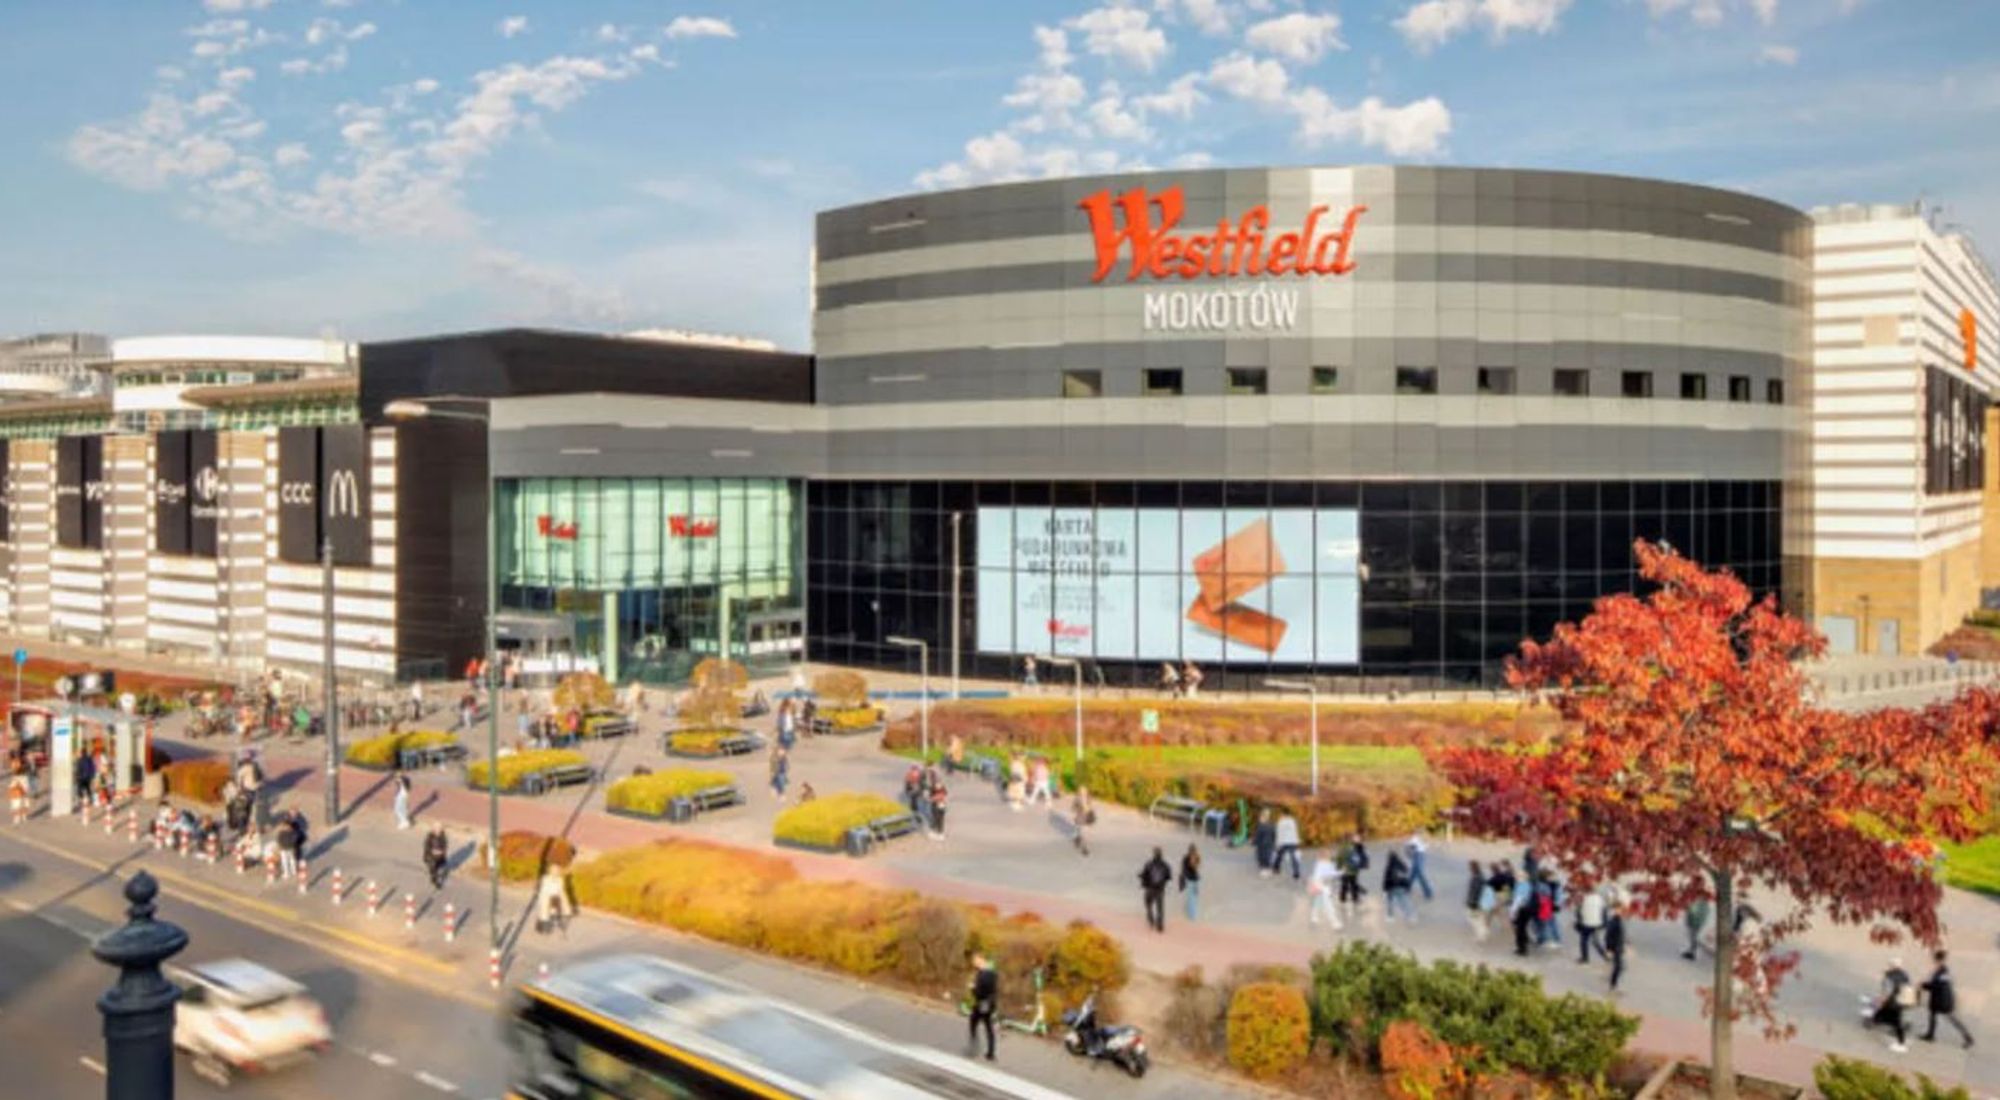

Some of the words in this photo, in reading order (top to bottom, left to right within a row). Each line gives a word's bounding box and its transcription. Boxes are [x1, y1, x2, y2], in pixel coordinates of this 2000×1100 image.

[1078, 185, 1368, 280] Westfield
[1143, 282, 1299, 329] MOKOTÓW
[281, 482, 312, 504] CCC
[1014, 538, 1126, 556] ODARUNKWA
[1028, 559, 1110, 578] WETFIED
